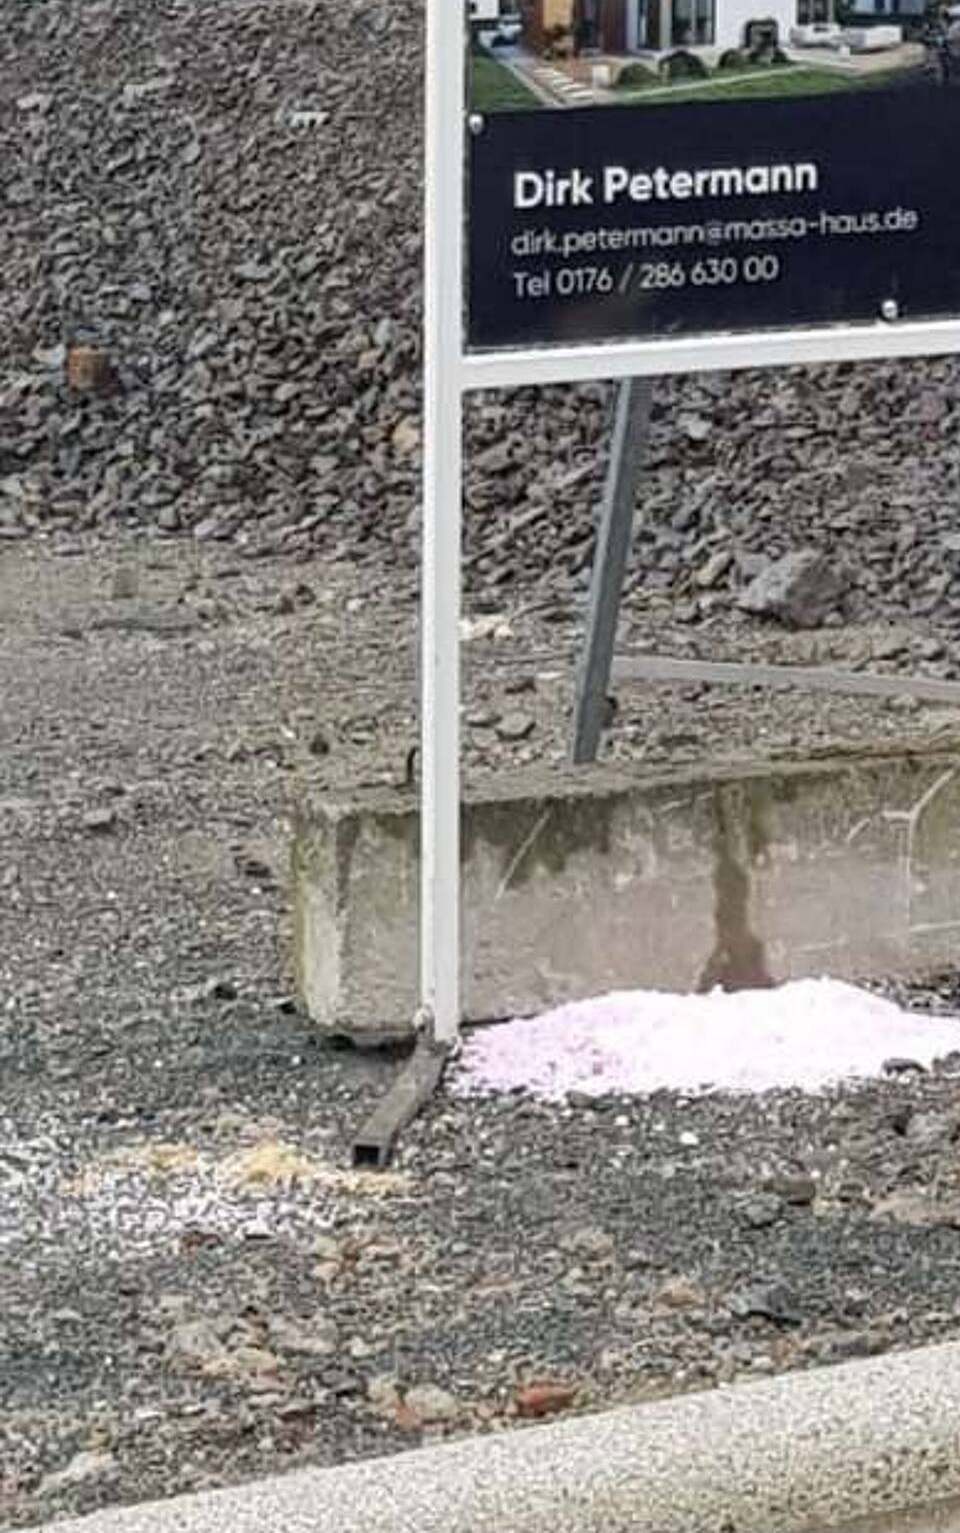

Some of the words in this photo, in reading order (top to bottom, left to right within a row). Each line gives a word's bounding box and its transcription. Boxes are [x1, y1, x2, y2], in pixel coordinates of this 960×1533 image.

[513, 169, 594, 209] Dirk
[603, 163, 819, 204] Petermann
[511, 206, 919, 257] dirk.petermann@massa-haus.de
[513, 271, 549, 297] Tel
[555, 265, 613, 296] 0176
[640, 262, 685, 290] 286
[690, 259, 738, 286] 630
[743, 255, 780, 282] 00
